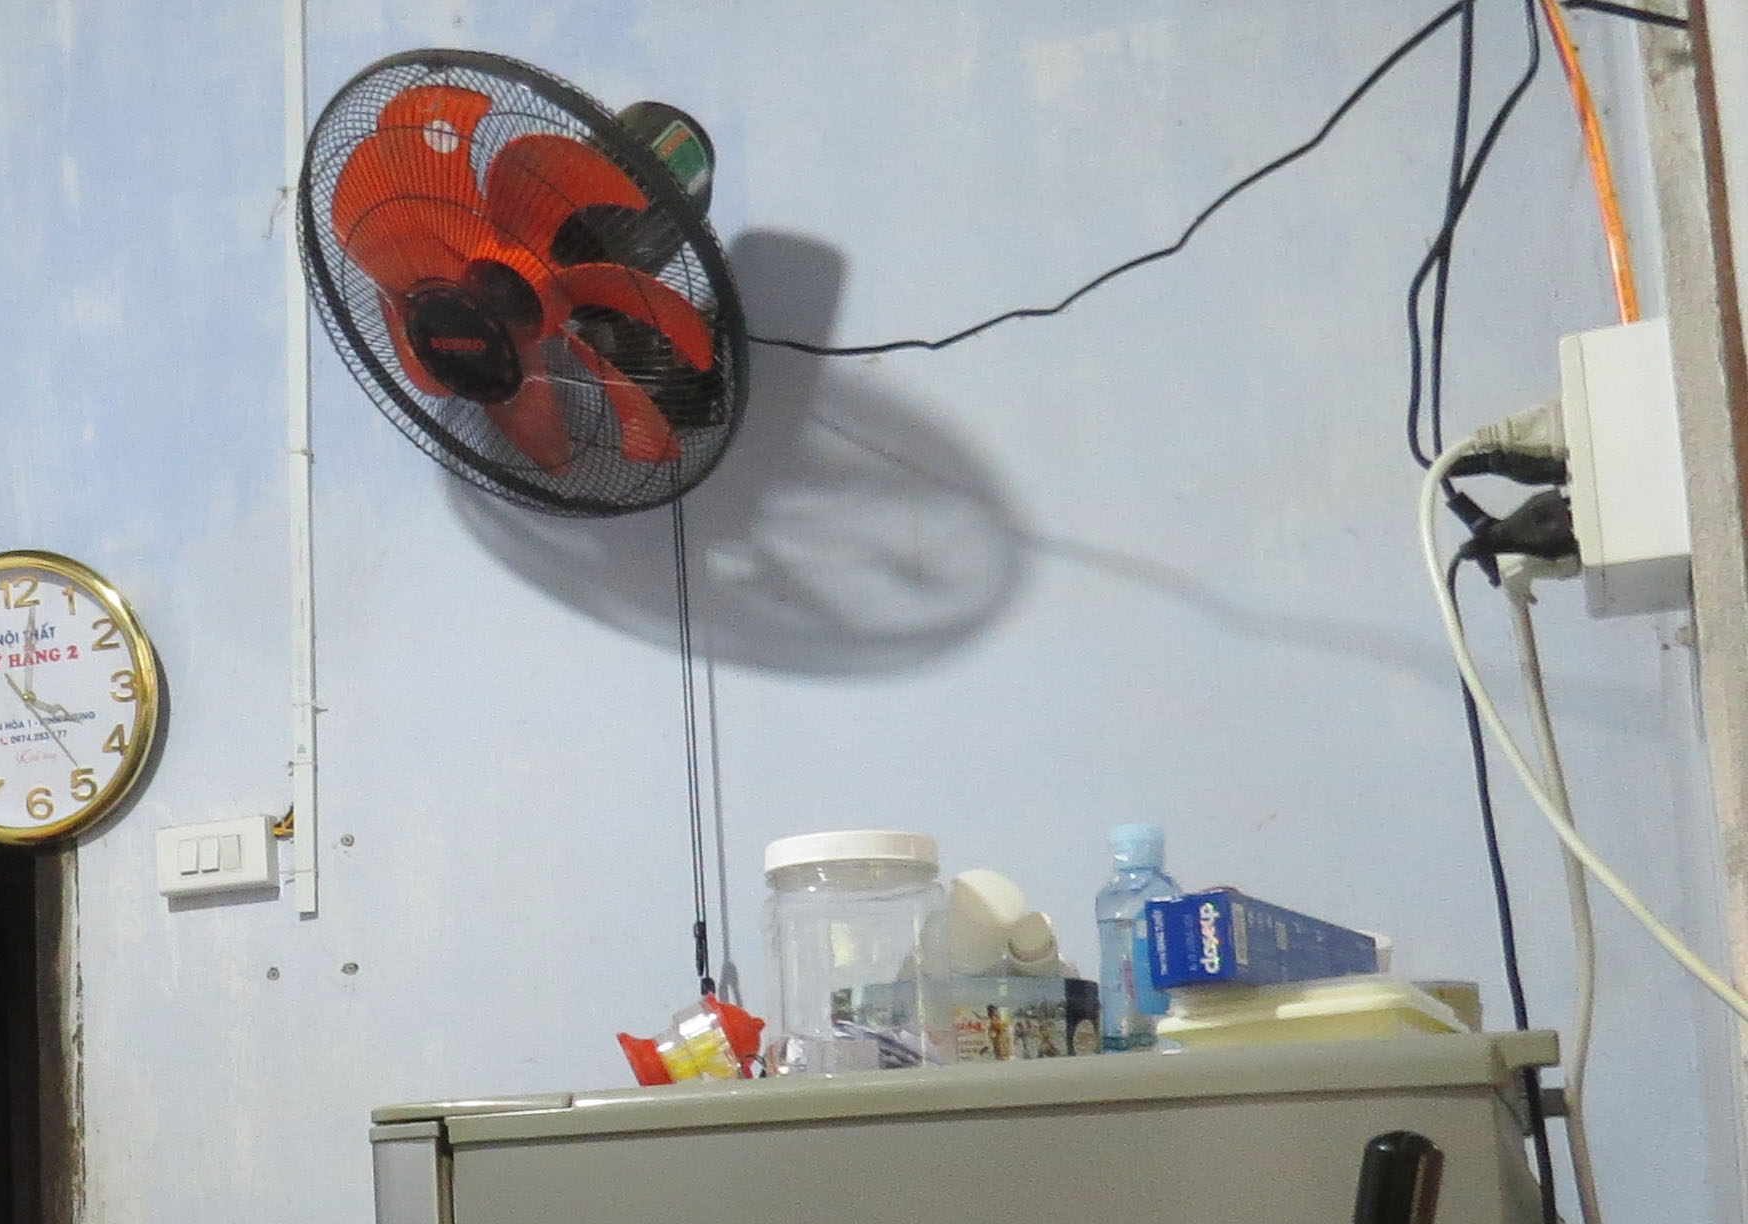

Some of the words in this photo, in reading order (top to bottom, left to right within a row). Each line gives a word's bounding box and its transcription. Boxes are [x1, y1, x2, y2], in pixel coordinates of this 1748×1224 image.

[62, 585, 77, 615] 1
[91, 619, 121, 651] 2
[66, 645, 79, 660] 2
[111, 670, 138, 702] 3
[103, 724, 129, 756] 4
[70, 768, 98, 802] 5
[26, 788, 54, 820] 6
[1198, 902, 1221, 975] closeup
